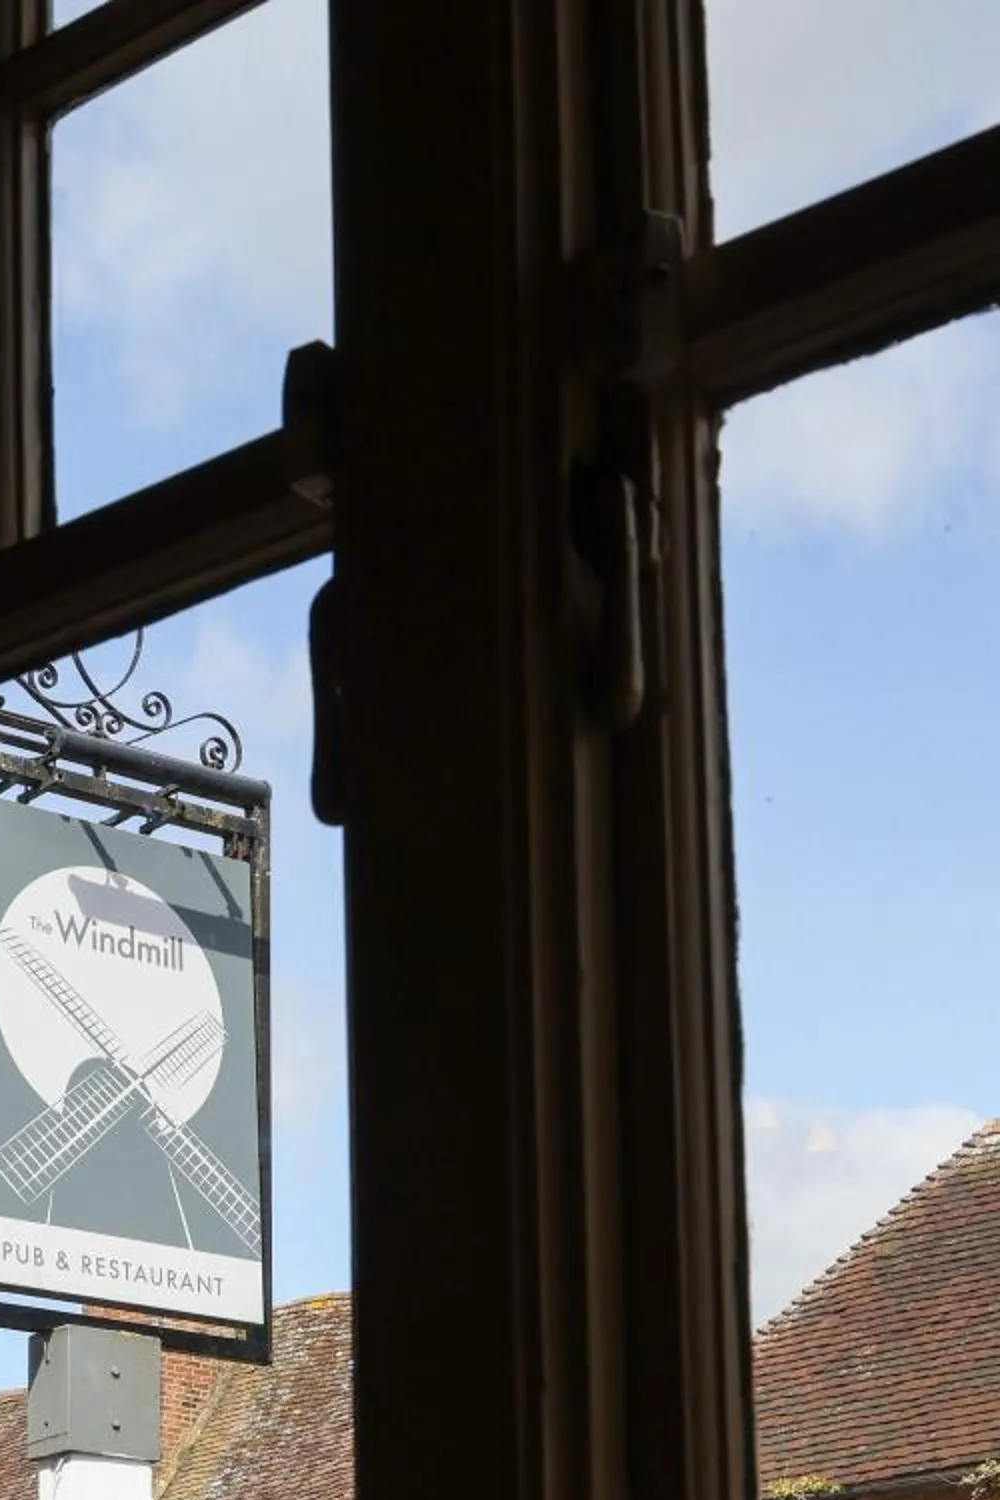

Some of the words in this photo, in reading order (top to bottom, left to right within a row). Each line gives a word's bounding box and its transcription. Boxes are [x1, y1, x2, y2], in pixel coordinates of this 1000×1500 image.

[54, 910, 184, 972] Windmill
[2, 1241, 45, 1267] PUB
[55, 1250, 70, 1271] &
[81, 1255, 225, 1296] RESTAURANT
